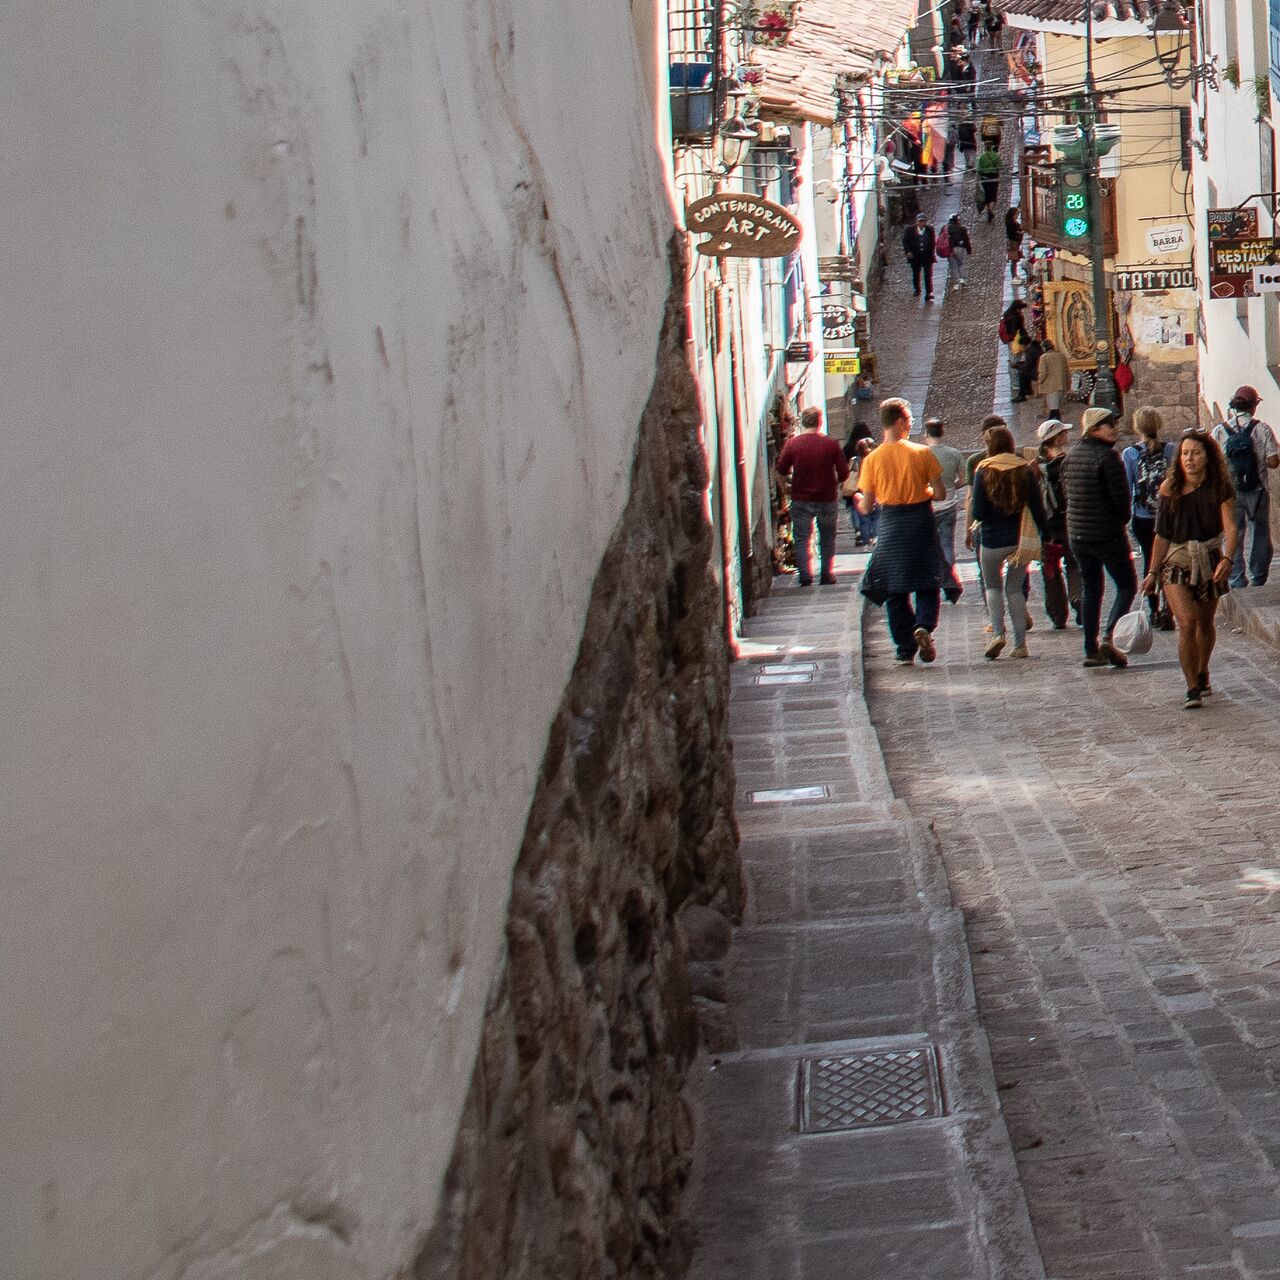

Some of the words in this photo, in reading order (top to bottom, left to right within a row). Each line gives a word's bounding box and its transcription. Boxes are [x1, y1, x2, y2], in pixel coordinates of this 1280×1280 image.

[723, 216, 771, 241] ART
[1153, 236, 1184, 247] BARRA
[1118, 269, 1194, 290] TATTOO
[823, 322, 856, 339] LERS
